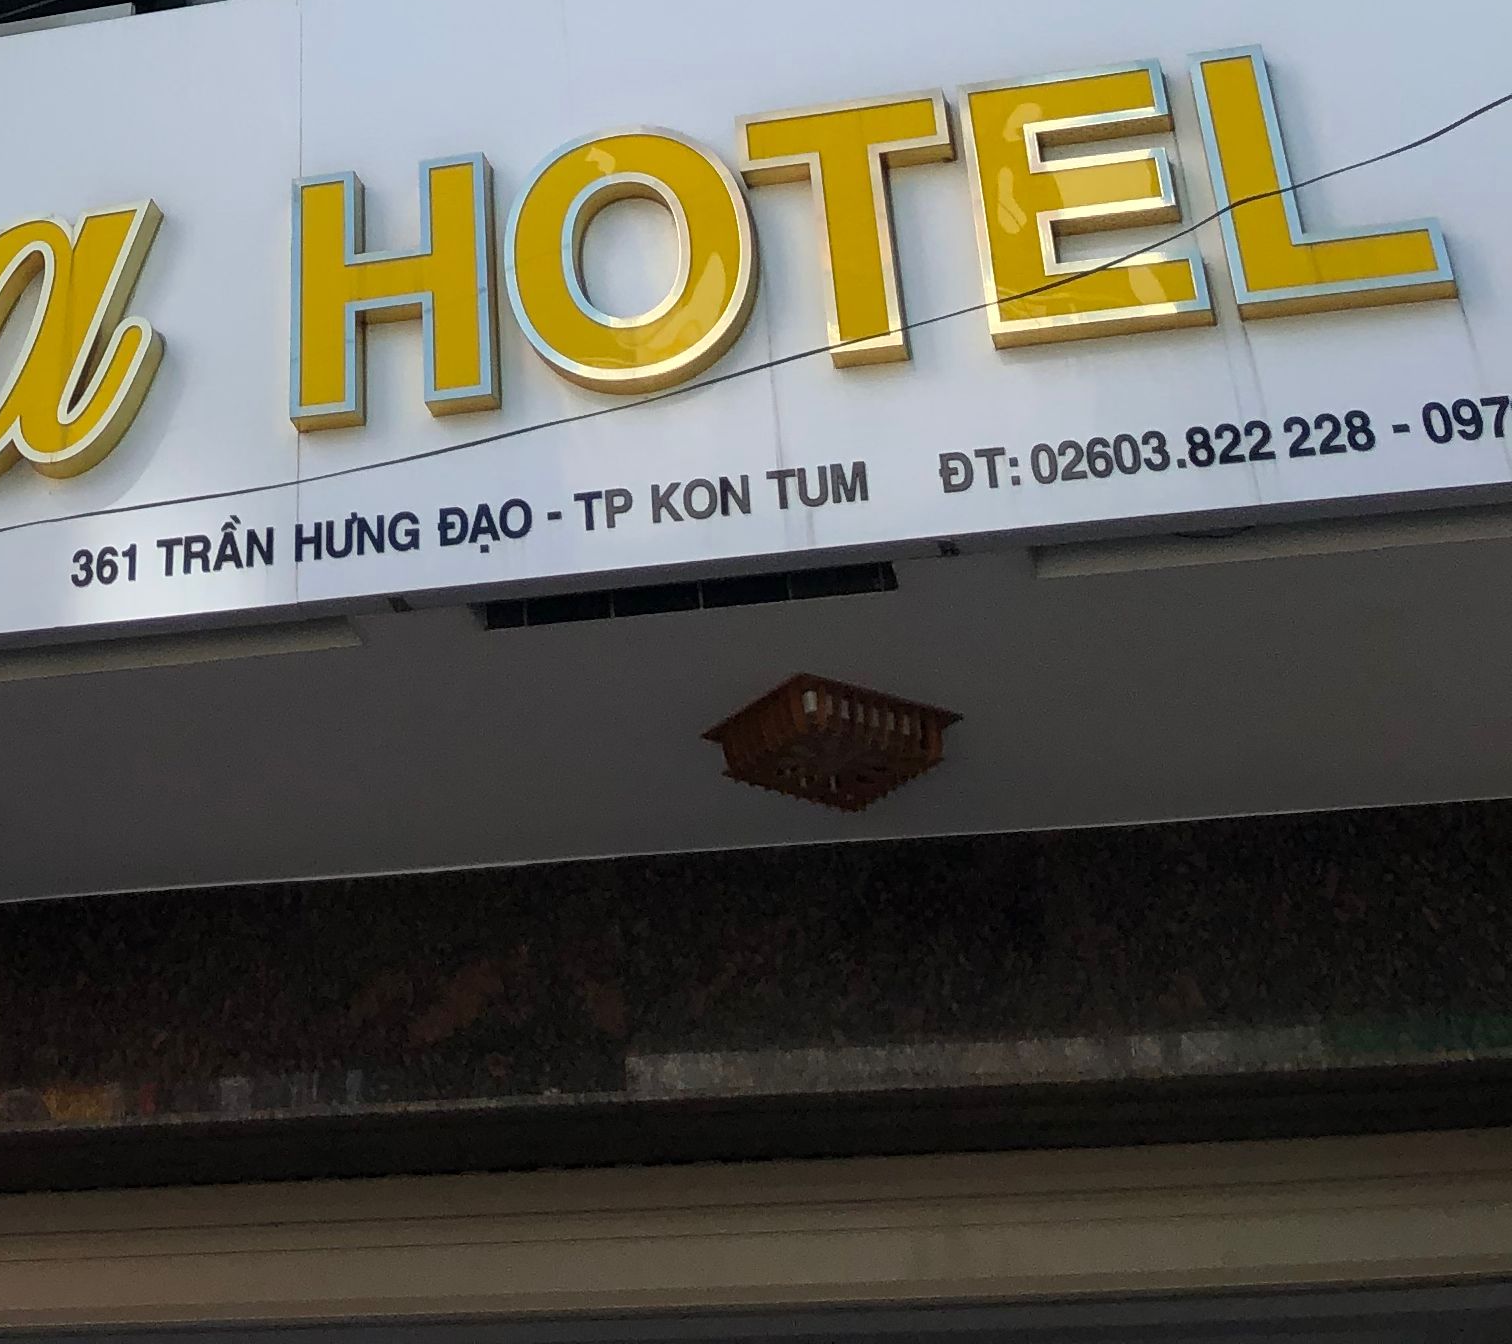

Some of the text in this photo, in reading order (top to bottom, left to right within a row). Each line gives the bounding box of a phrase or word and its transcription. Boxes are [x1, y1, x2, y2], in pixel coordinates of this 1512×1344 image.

[289, 43, 1458, 434] HOTEL
[71, 542, 138, 589] 361
[155, 514, 275, 577] TRẦN
[294, 510, 420, 563] HƯNG
[437, 498, 534, 554] ĐẠO
[573, 487, 634, 531] TP
[650, 474, 752, 525] KON
[765, 460, 870, 510] TUM
[1421, 395, 1512, 445] 097
